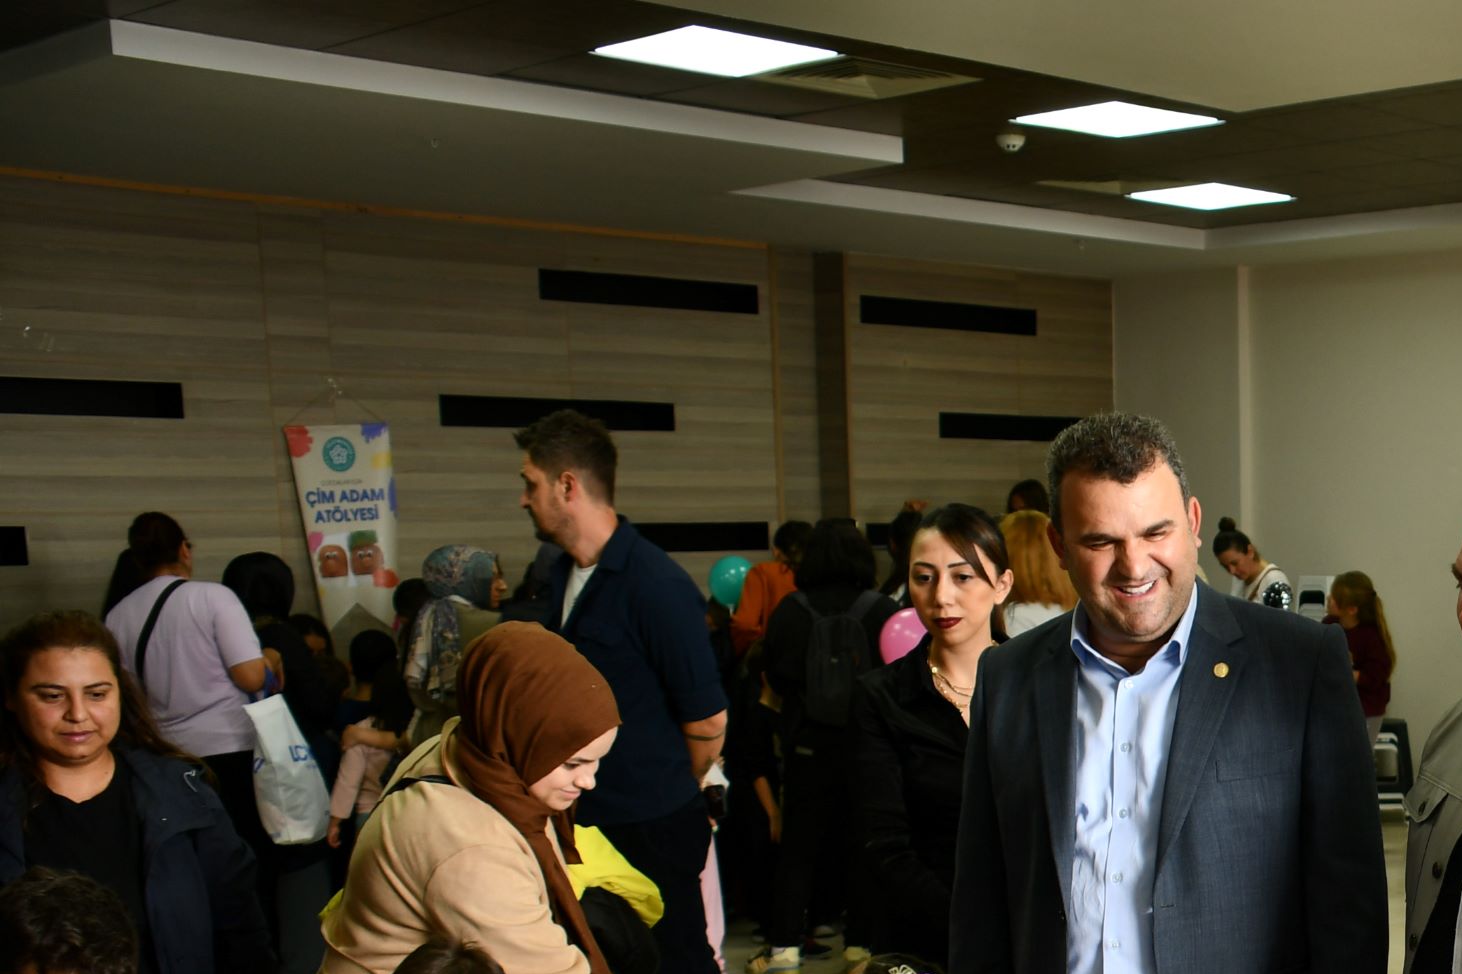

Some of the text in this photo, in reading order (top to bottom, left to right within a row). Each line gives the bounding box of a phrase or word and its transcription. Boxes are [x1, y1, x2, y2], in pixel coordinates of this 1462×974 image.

[305, 487, 385, 508] ÇİM ADAM
[315, 504, 379, 523] ATÖLYESİ
